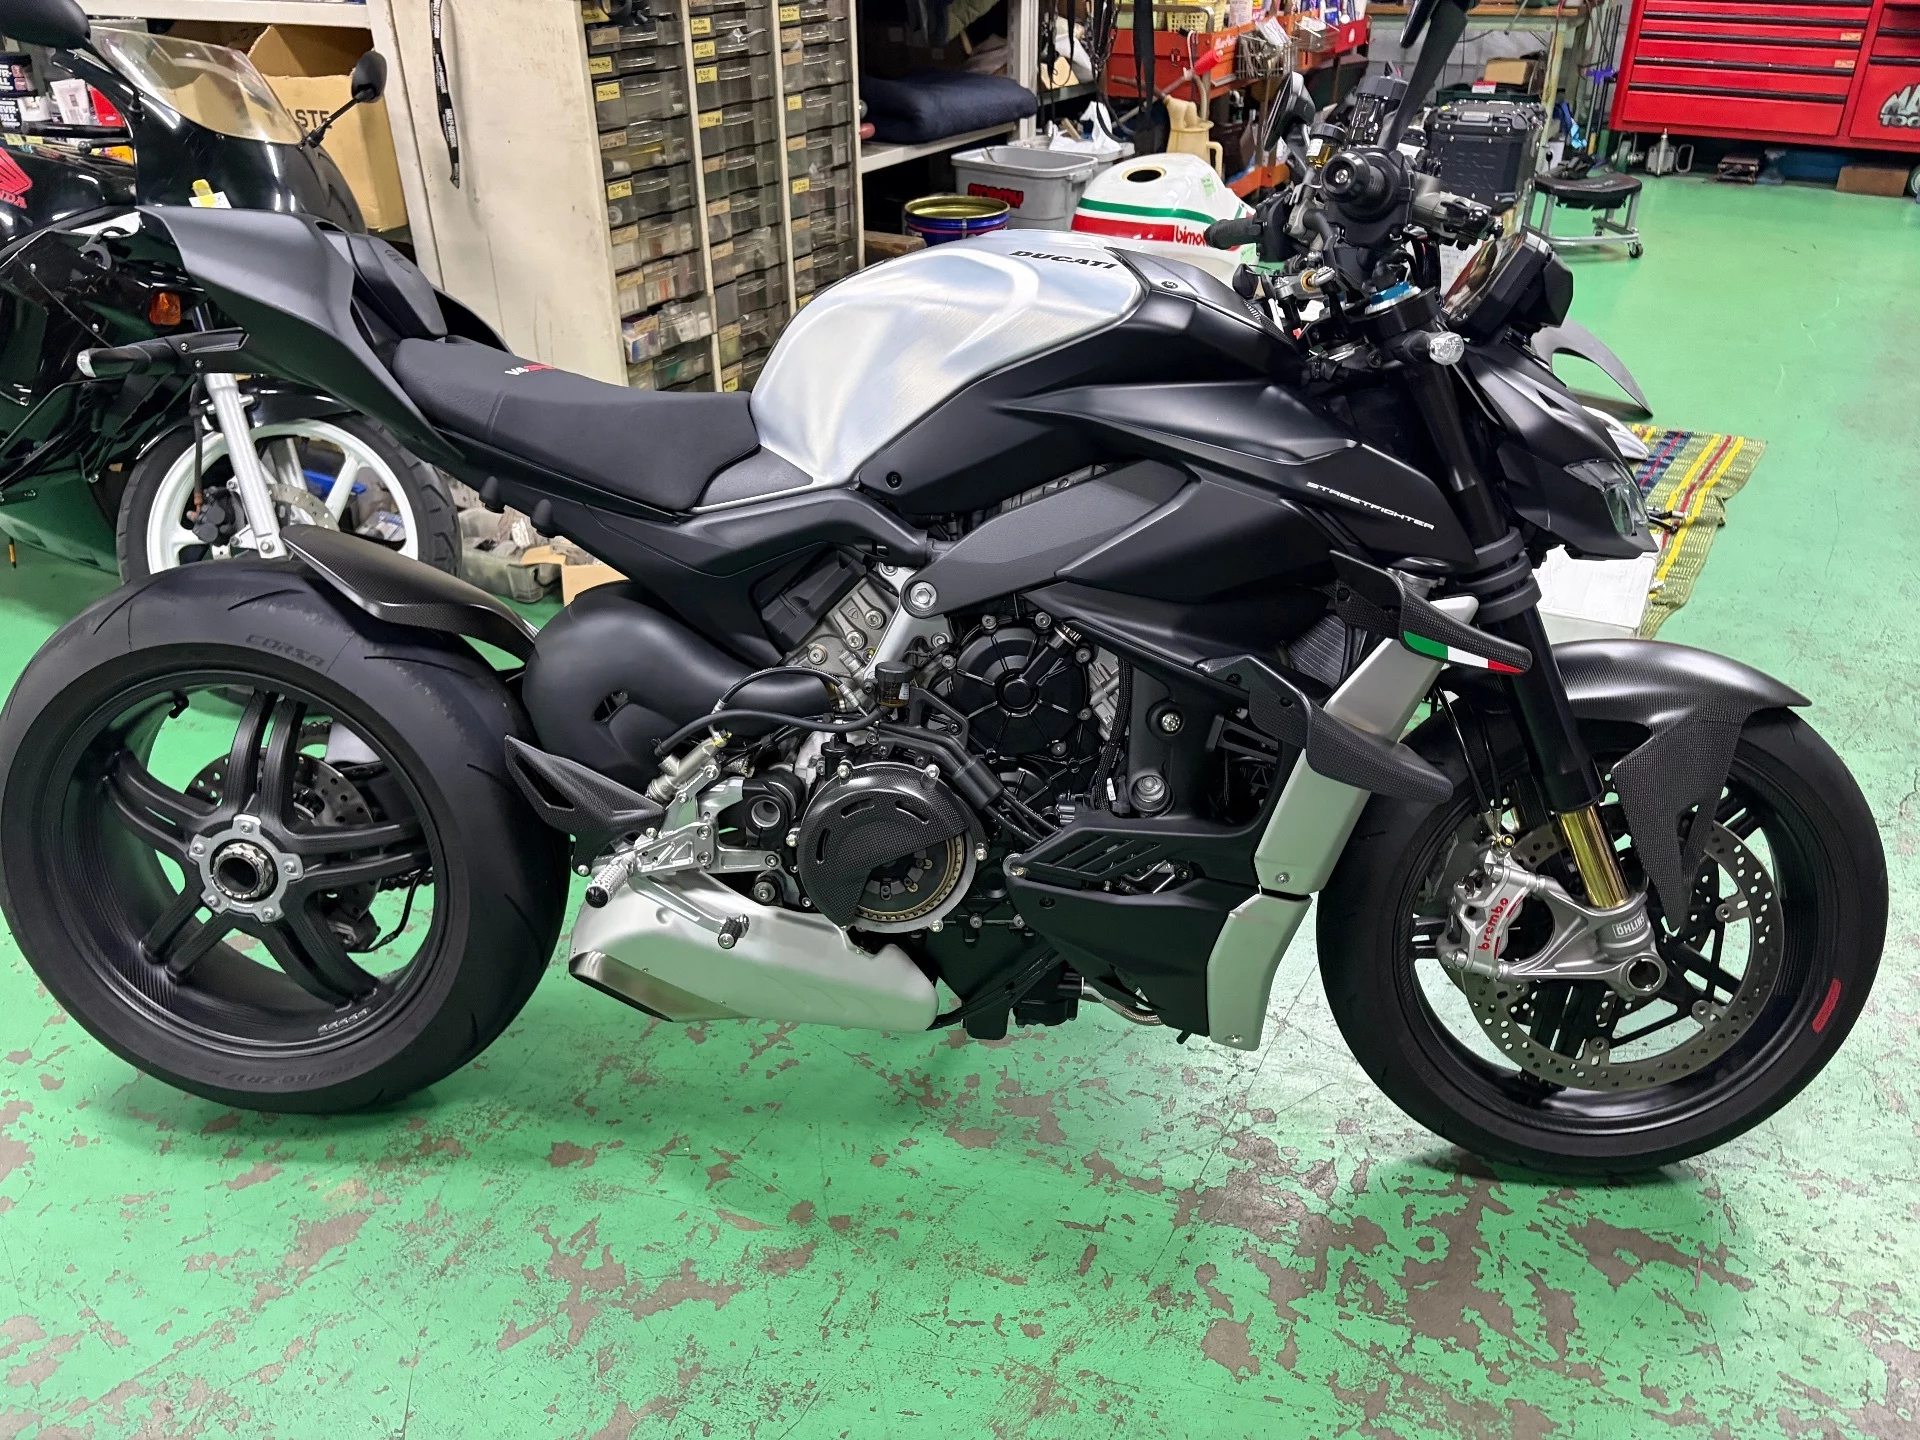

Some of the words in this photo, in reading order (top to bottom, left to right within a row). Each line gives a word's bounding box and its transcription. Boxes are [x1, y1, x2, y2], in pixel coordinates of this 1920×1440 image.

[287, 108, 332, 128] STE
[1176, 225, 1206, 247] bimo
[1009, 250, 1119, 269] DUCATI
[1306, 481, 1435, 530] STREETFIGHTER
[246, 634, 325, 666] CORSA
[1477, 897, 1509, 951] brembo
